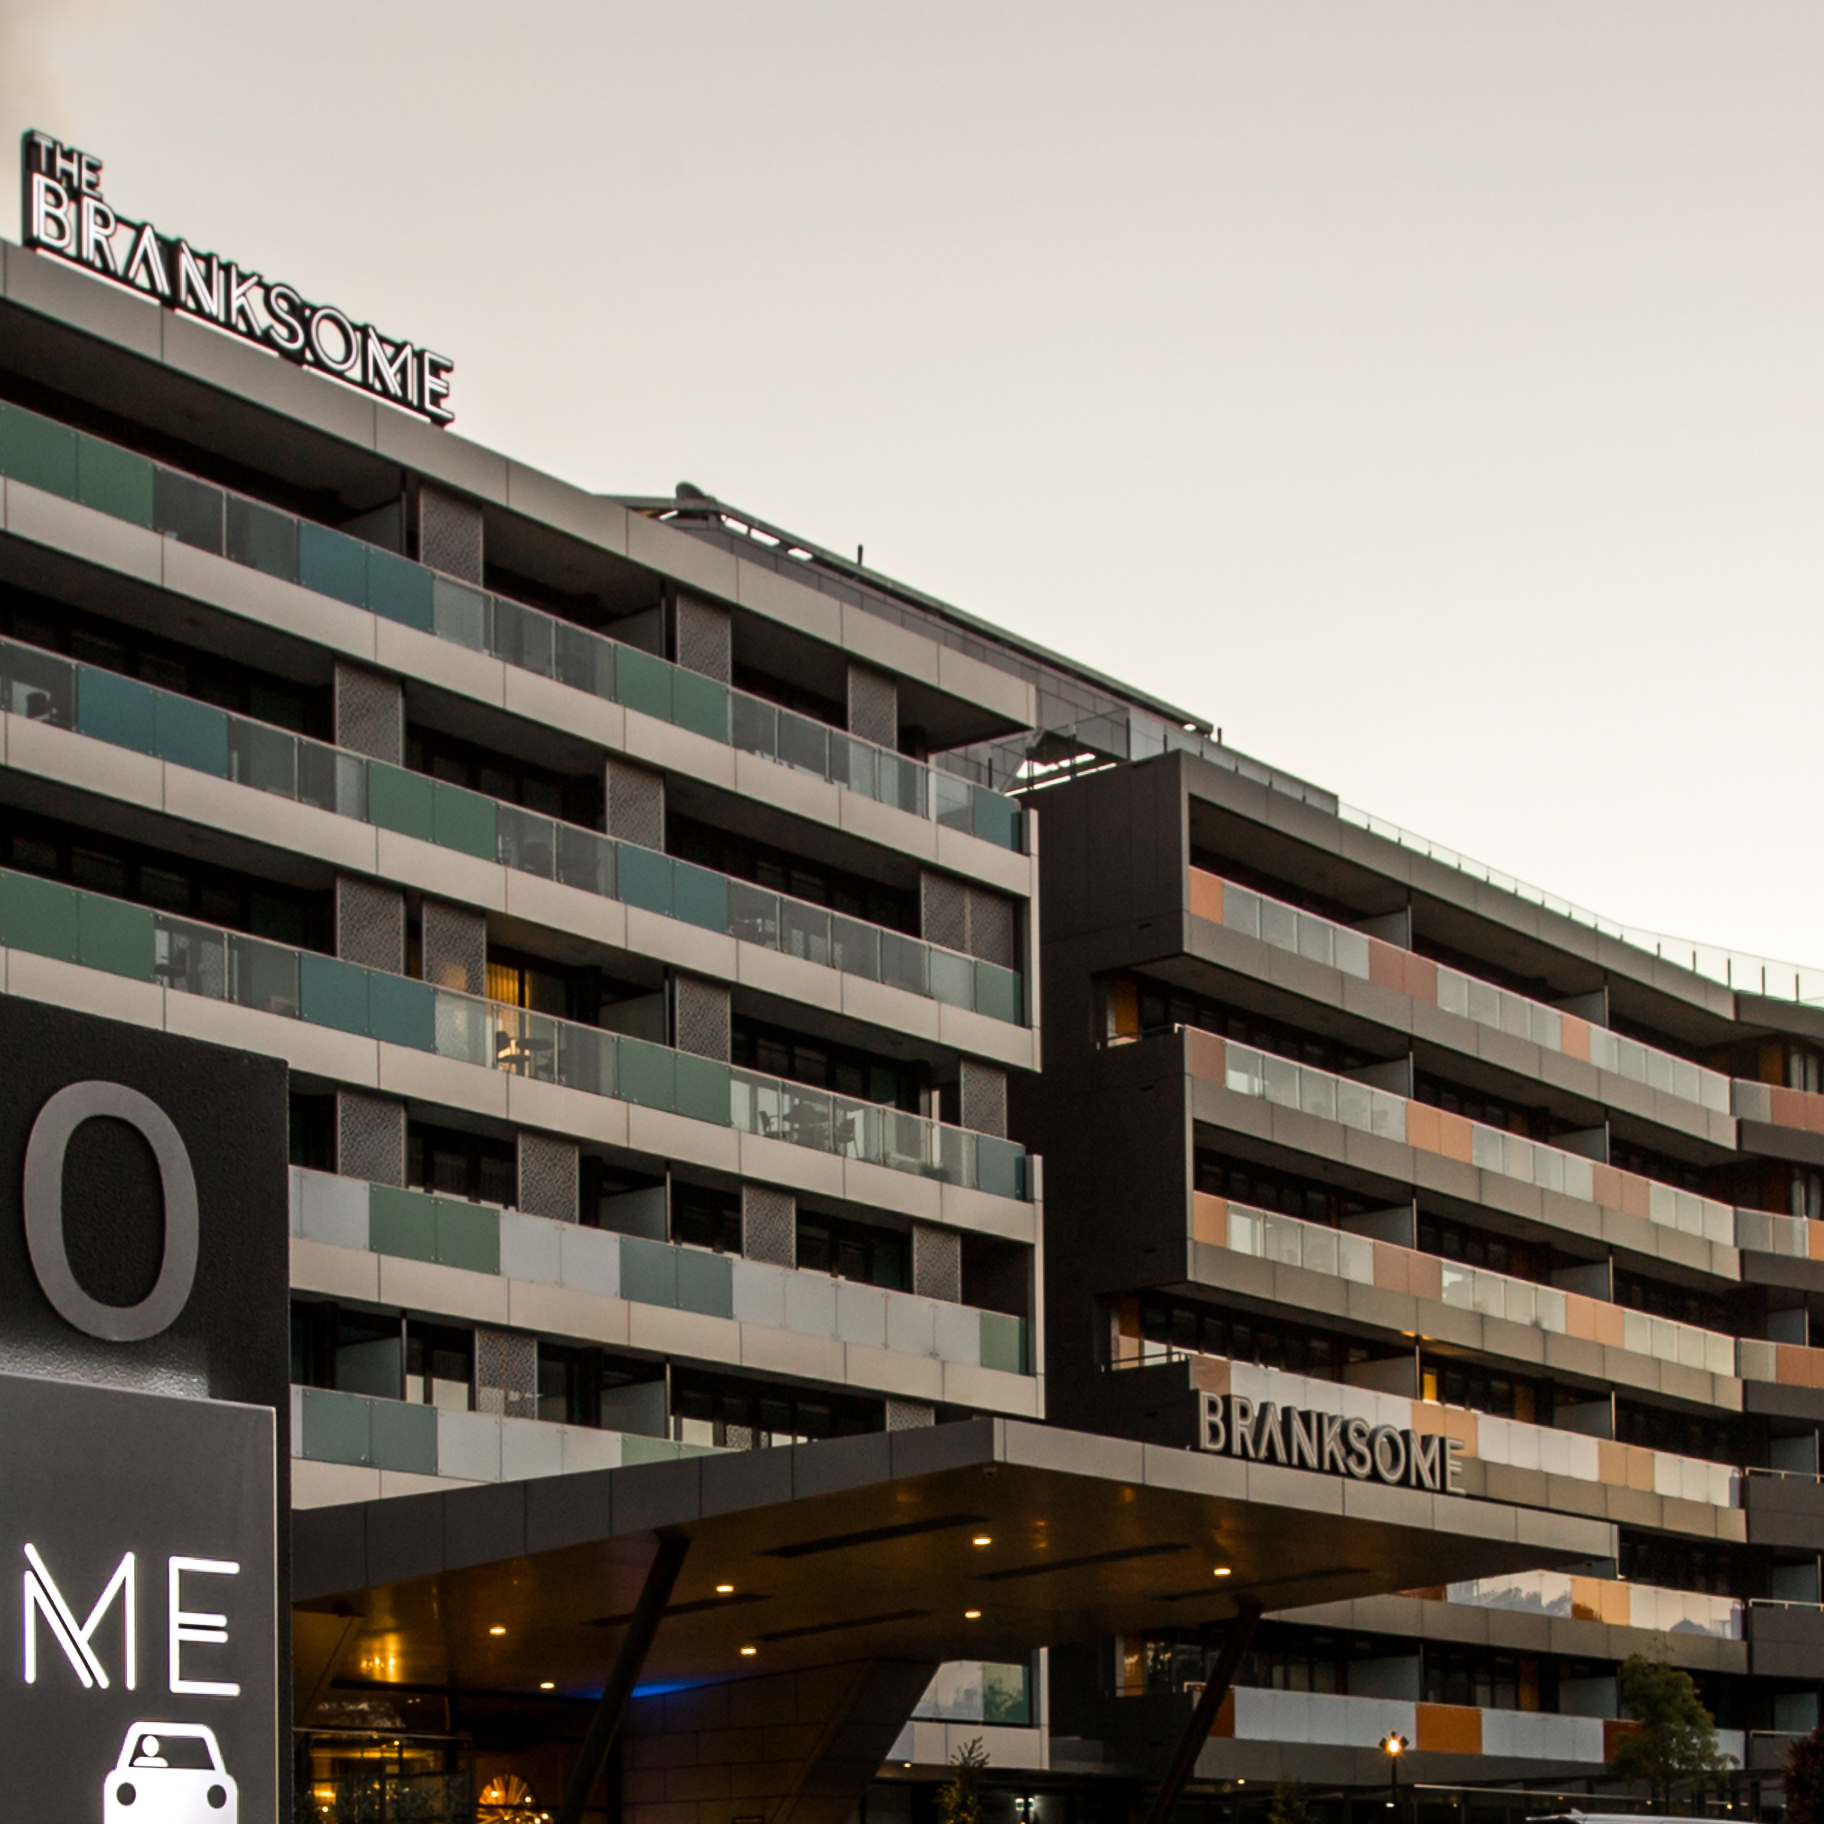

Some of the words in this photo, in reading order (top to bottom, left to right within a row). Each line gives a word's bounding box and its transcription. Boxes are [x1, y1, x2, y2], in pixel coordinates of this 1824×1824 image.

[33, 131, 103, 198] THE
[31, 172, 454, 420] BRANKSOME
[1197, 1389, 1467, 1495] BRANKSOME
